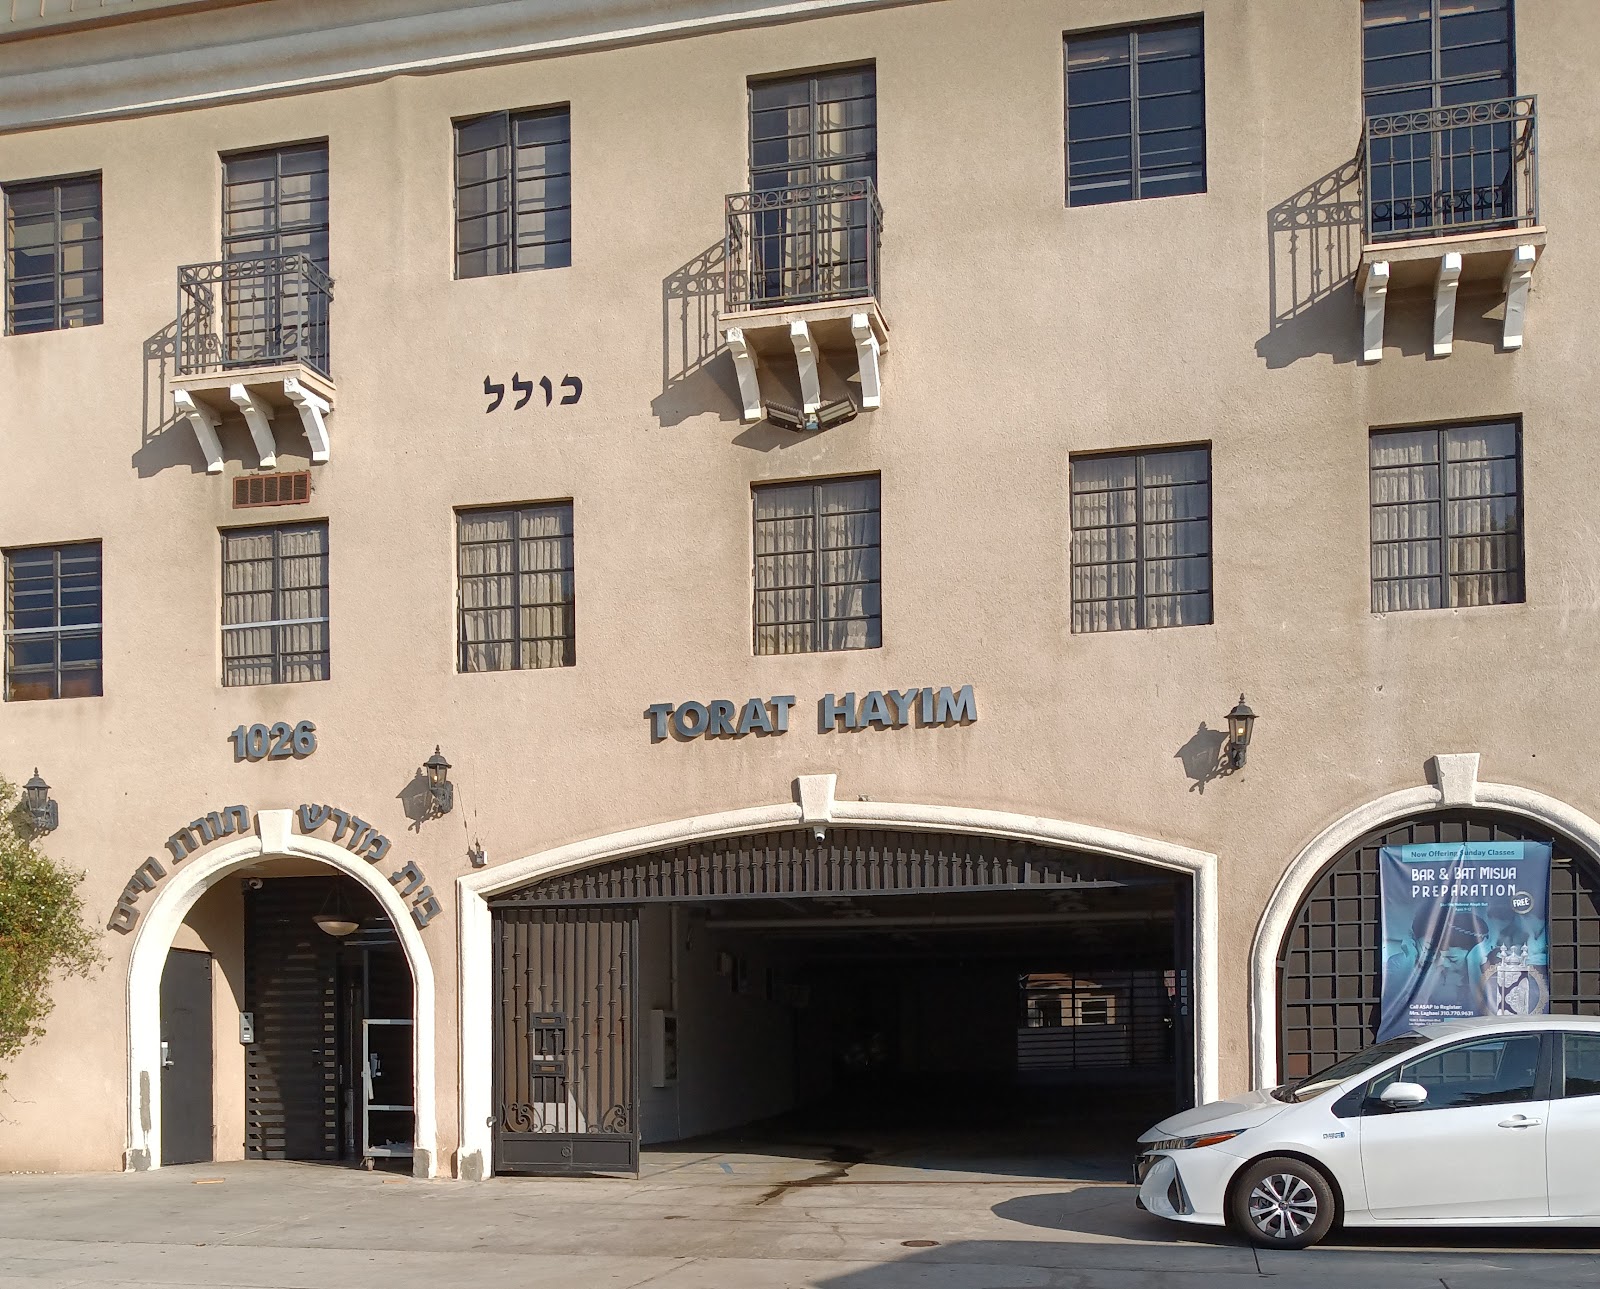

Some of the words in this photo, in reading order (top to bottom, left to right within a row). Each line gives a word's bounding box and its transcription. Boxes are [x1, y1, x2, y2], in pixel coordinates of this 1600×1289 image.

[483, 371, 583, 414] כולל
[646, 695, 796, 742] TORAT
[820, 685, 977, 732] HAYIM
[229, 720, 317, 760] 1026
[166, 805, 251, 863] תורת
[297, 803, 392, 862] מדרש
[1428, 850, 1458, 859] Offering
[1459, 849, 1486, 857] Sunday
[107, 856, 167, 934] חיים
[391, 860, 443, 929] בית
[1411, 868, 1435, 881] BAR
[1439, 867, 1449, 880] &
[1454, 867, 1476, 880] BAT
[1412, 884, 1516, 898] PREPARATION
[1512, 897, 1530, 908] FREE
